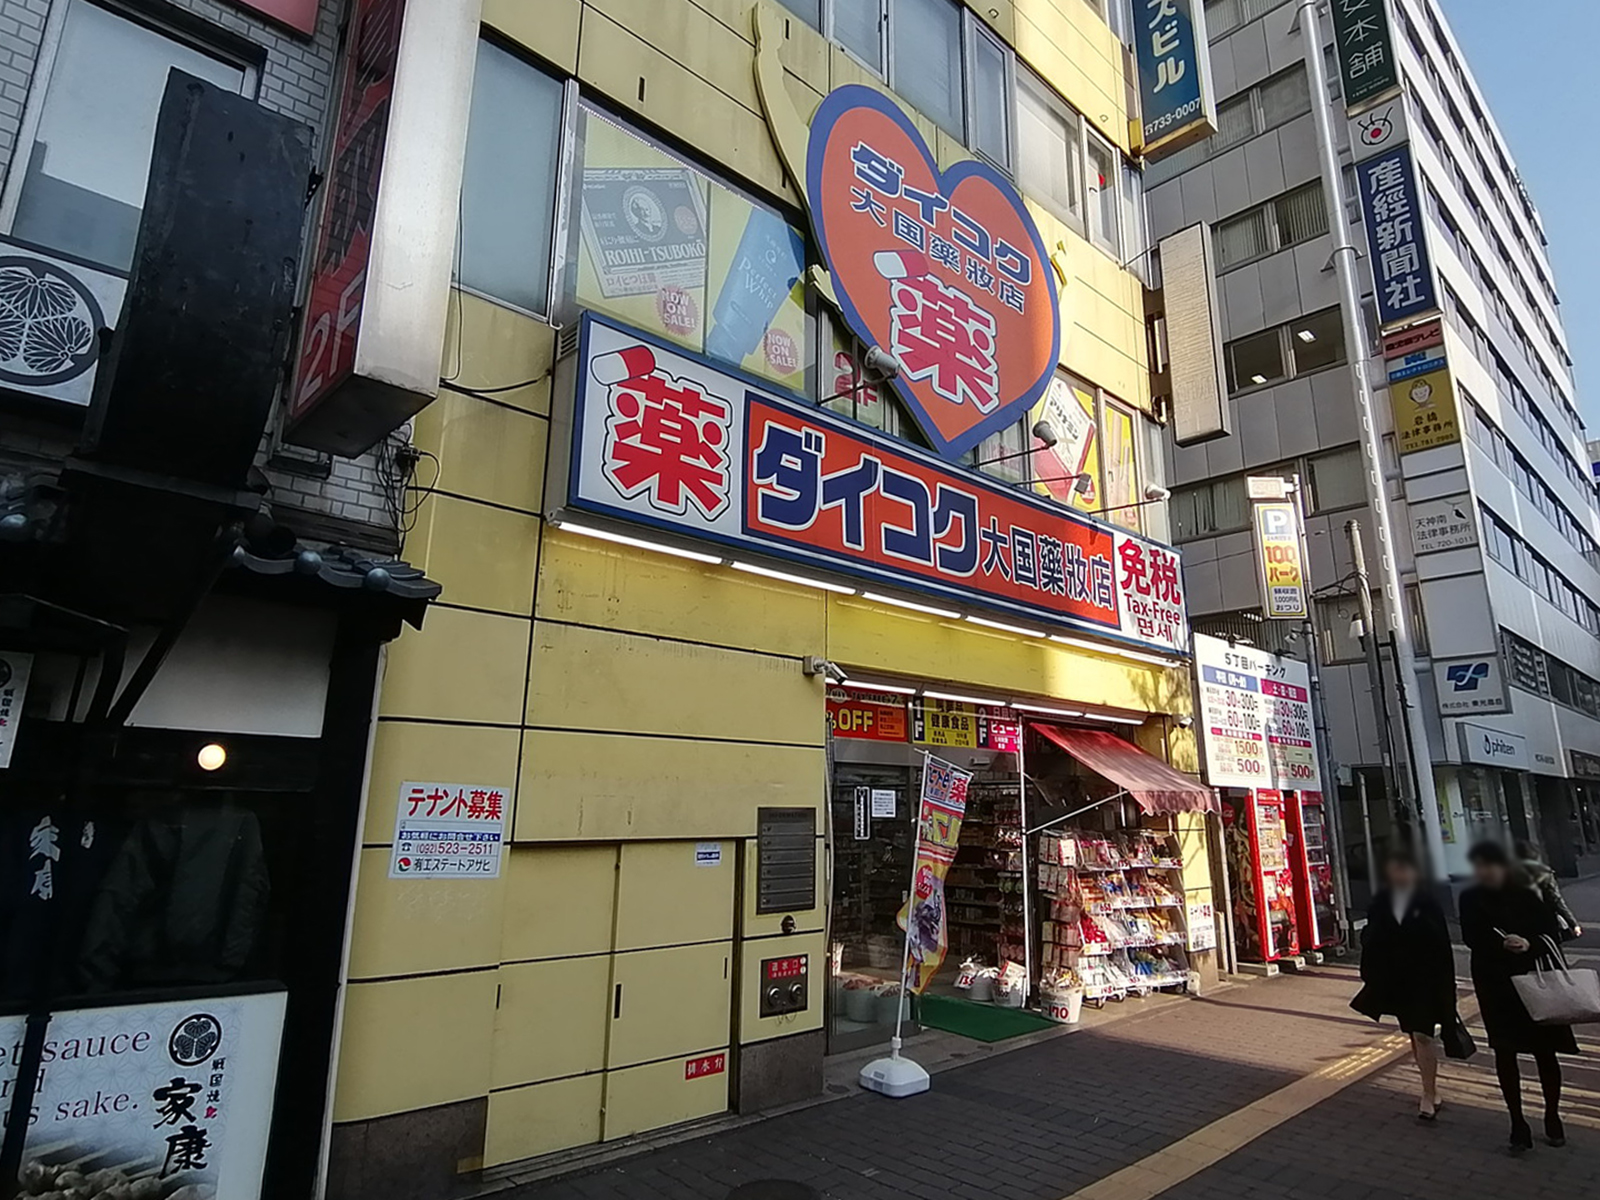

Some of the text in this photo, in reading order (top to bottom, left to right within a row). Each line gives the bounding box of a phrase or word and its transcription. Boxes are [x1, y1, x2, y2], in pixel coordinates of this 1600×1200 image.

[850, 141, 1031, 285] ダイコク
[738, 257, 779, 299] Perfect
[744, 273, 774, 310] Whip
[661, 290, 690, 305] NOW
[666, 303, 687, 316] ON
[664, 313, 696, 329] SALE!
[767, 333, 791, 348] NOW
[772, 345, 790, 356] ON
[891, 273, 997, 409] 薬
[769, 353, 798, 368] SALE!
[609, 373, 729, 517] 薬
[754, 419, 979, 577] ダイコク
[1266, 510, 1288, 533] P
[1415, 514, 1448, 529] 天神南
[1416, 521, 1472, 541] 法律事務所
[1118, 538, 1181, 606] 免税
[1124, 592, 1181, 626] Tax-Free
[1137, 617, 1173, 643] 면세
[931, 713, 969, 731] 健康食品
[1492, 738, 1516, 757] phiten
[408, 787, 503, 820] テナント募集
[41, 1031, 151, 1063] sauce
[54, 1091, 139, 1123] sake.
[152, 1076, 213, 1180] 家康
